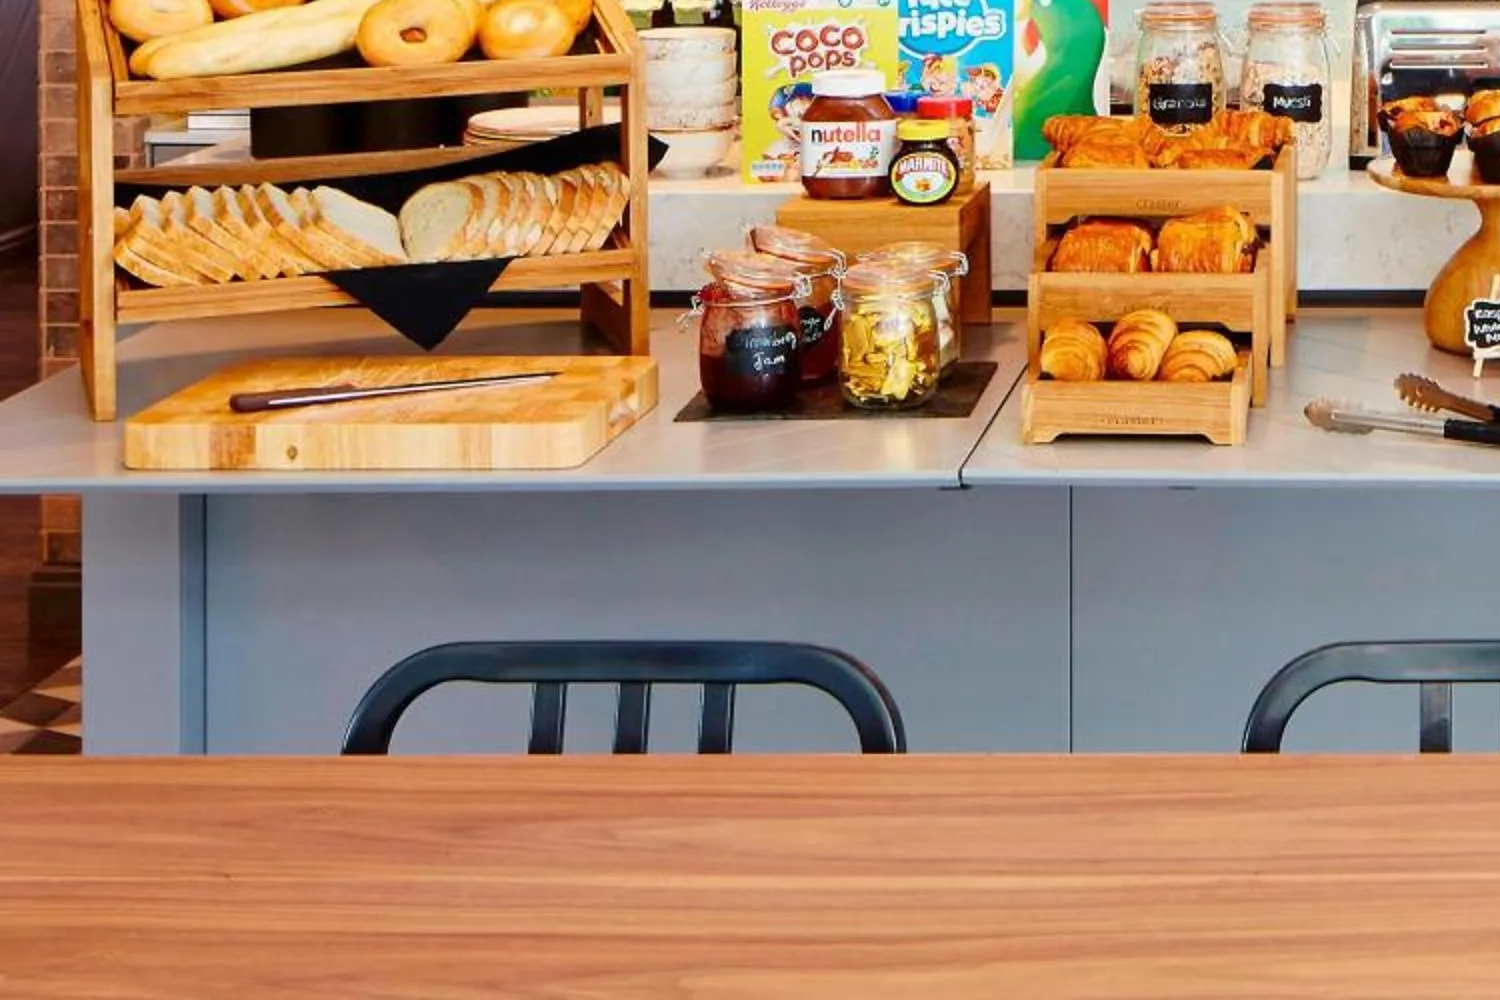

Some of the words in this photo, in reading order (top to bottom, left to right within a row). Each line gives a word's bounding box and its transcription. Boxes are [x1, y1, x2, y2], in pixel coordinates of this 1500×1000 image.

[899, 8, 1003, 38] rispies
[790, 49, 856, 78] pops
[811, 122, 881, 143] nutella
